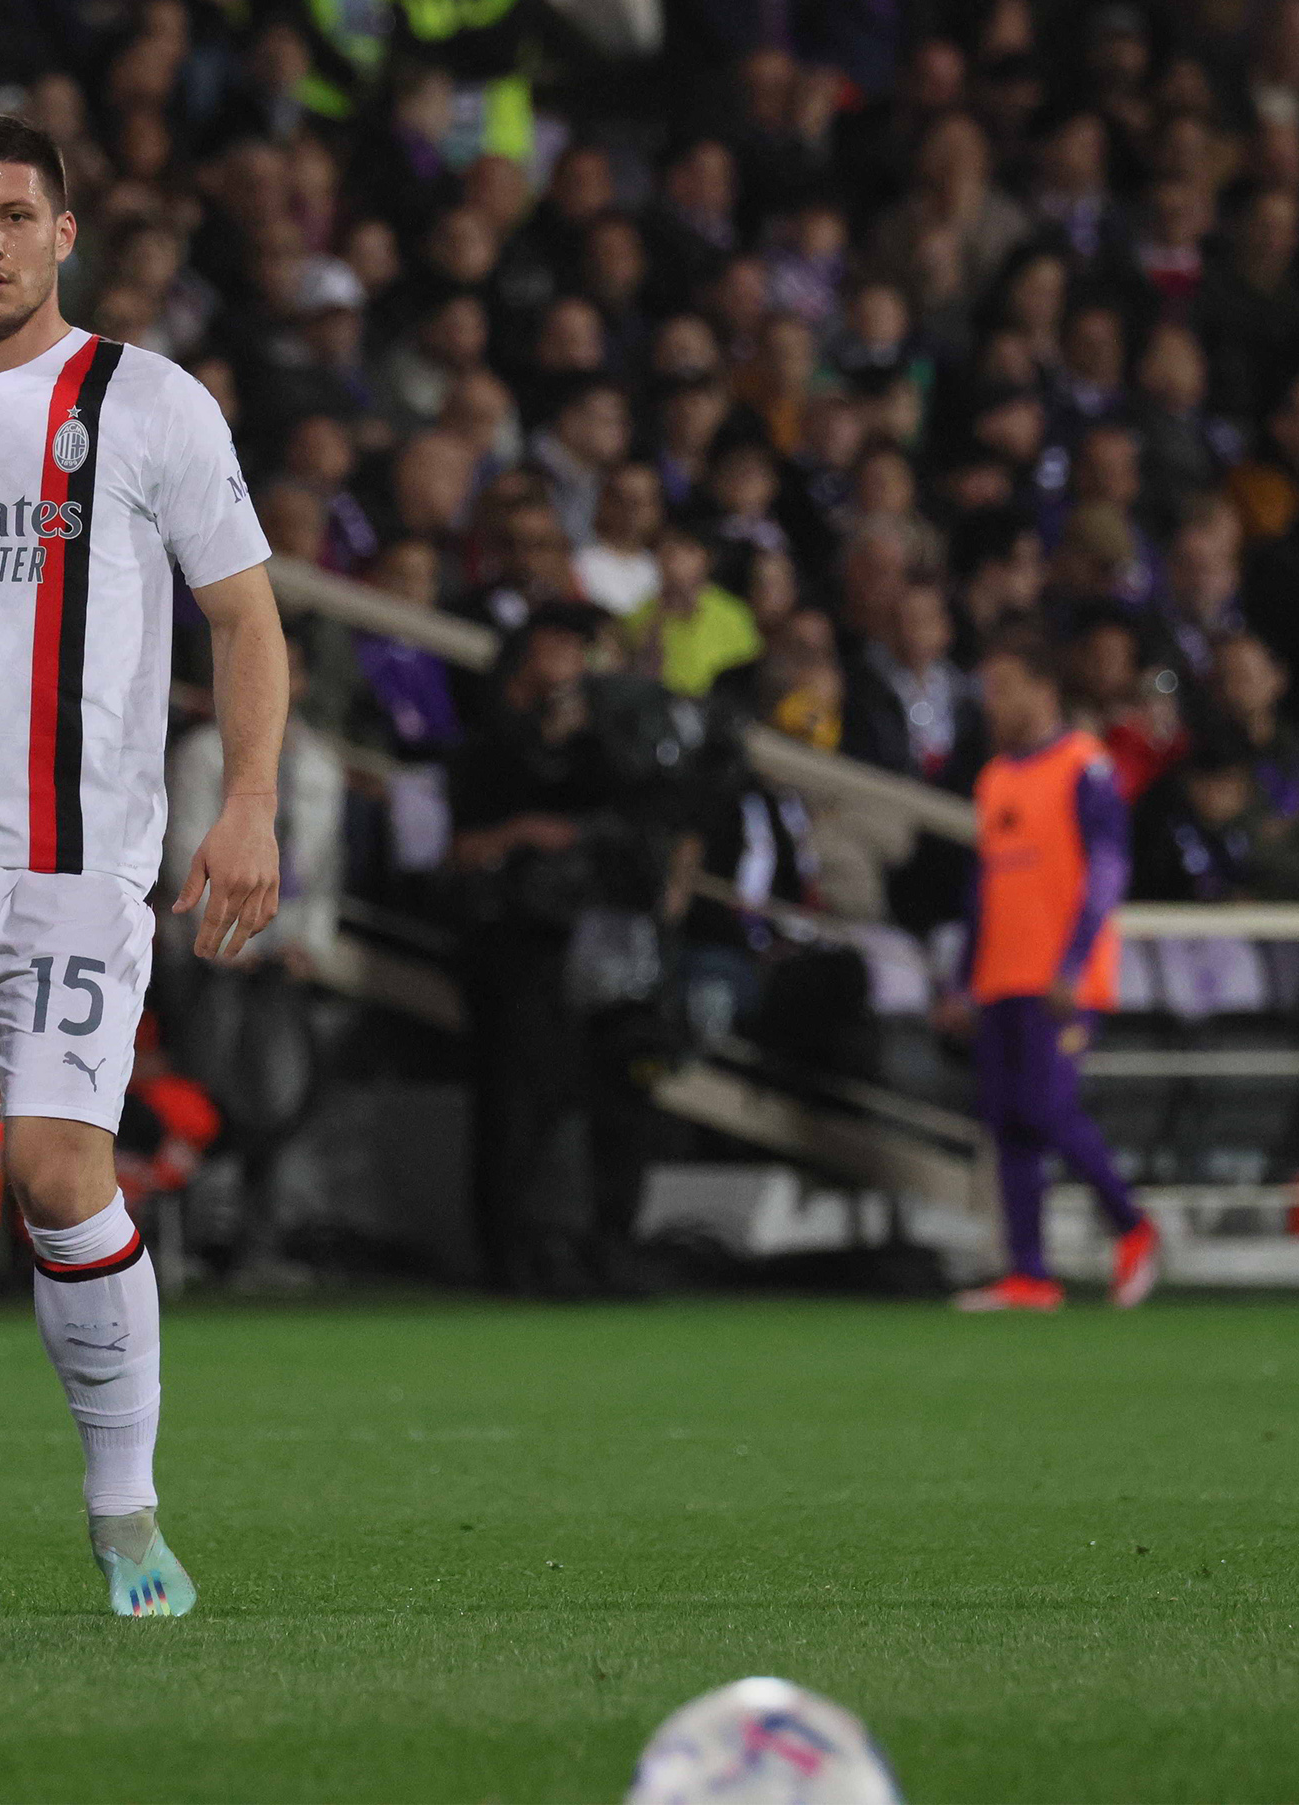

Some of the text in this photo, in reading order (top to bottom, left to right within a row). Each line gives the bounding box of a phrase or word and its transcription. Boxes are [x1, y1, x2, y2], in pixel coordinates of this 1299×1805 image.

[62, 423, 82, 434] ACM
[61, 459, 78, 467] 1899
[29, 955, 106, 1037] 15
